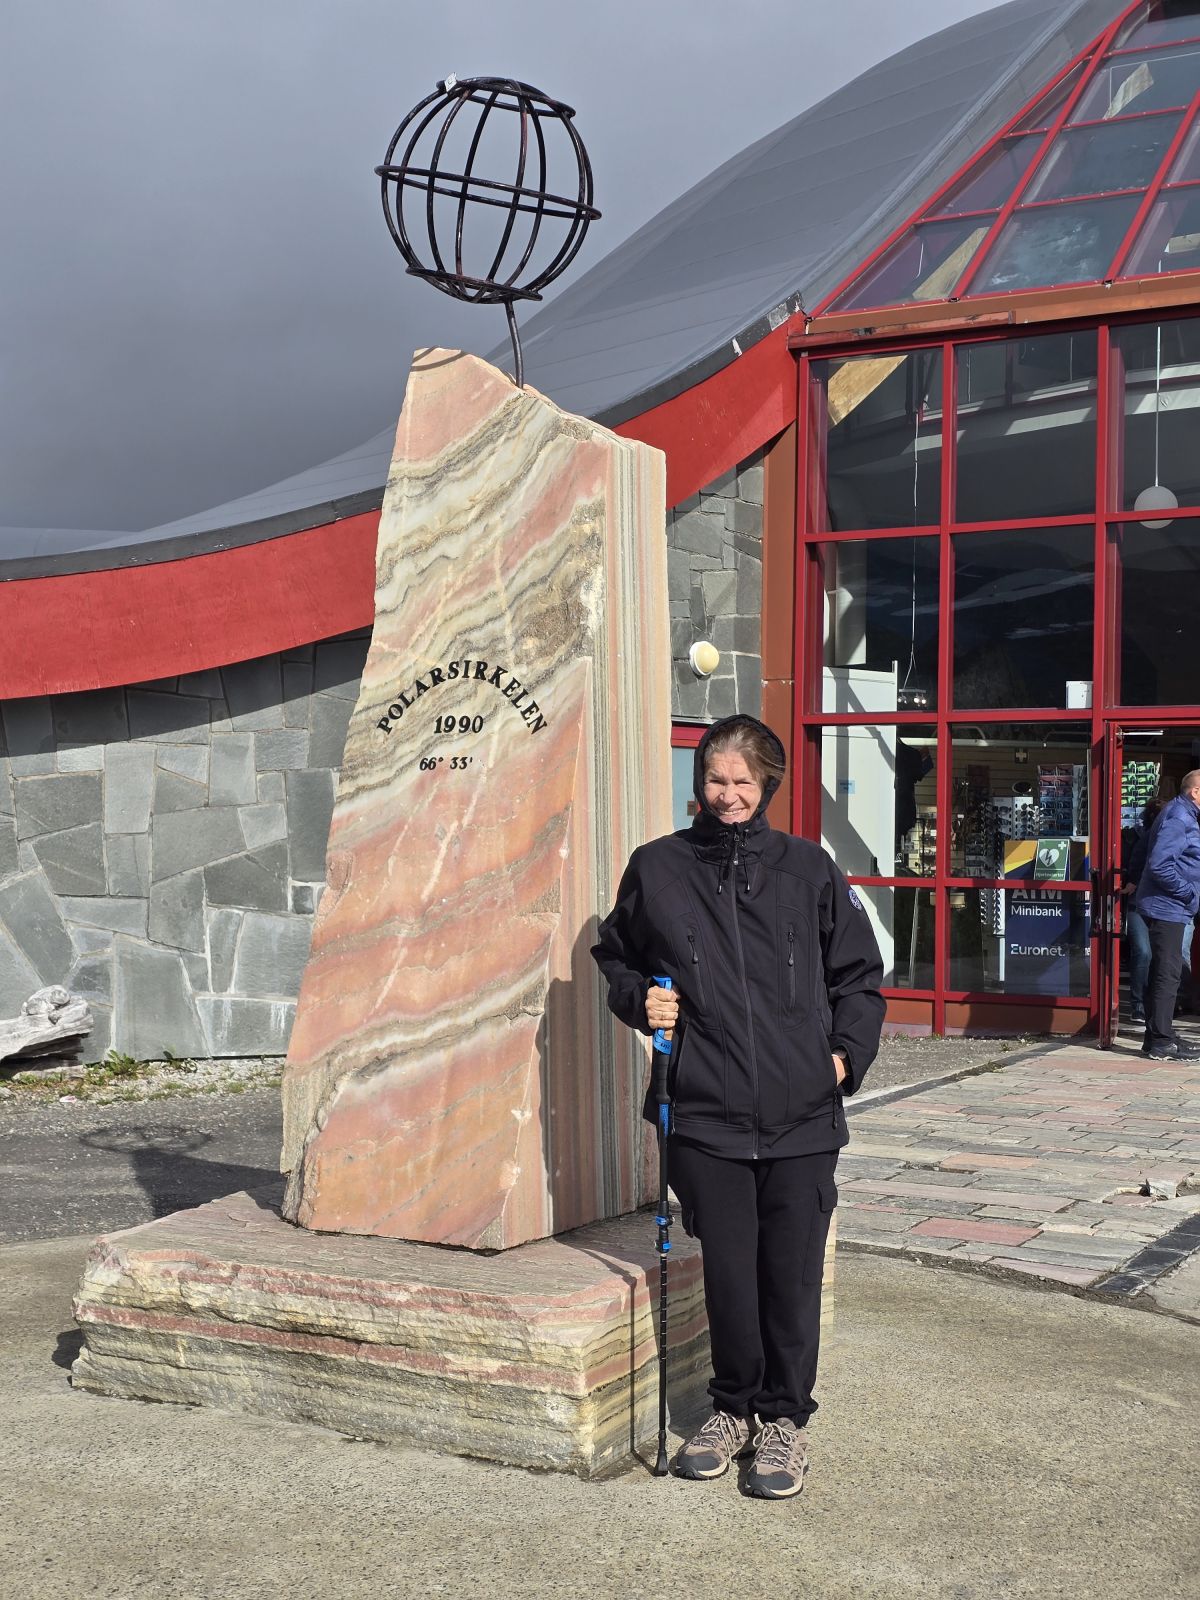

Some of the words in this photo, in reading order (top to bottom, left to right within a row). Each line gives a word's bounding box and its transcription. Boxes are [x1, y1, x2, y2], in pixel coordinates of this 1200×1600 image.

[377, 660, 547, 735] POLARSIRKELEN
[434, 715, 484, 734] 1990
[419, 757, 444, 771] 66°
[1011, 905, 1062, 917] Minibank
